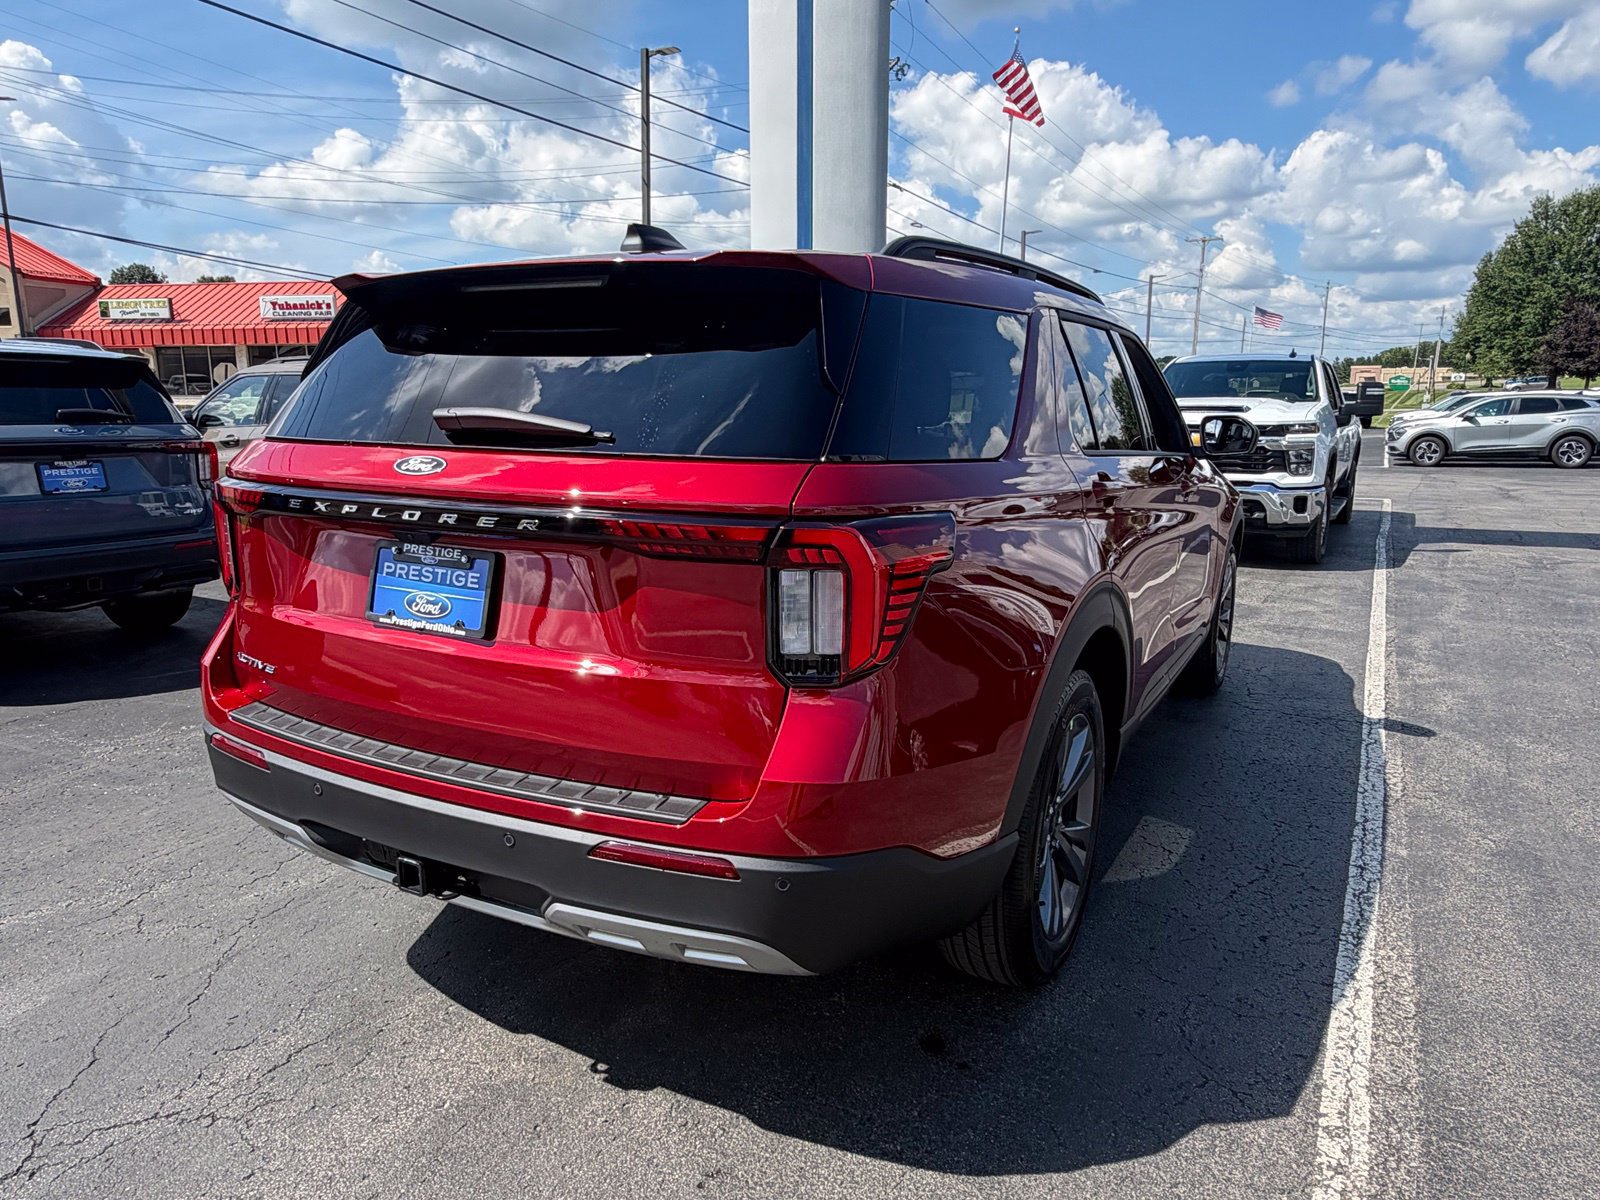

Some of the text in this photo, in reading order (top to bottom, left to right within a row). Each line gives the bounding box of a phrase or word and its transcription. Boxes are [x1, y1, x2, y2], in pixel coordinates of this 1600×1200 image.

[110, 300, 168, 309] LEMON TREE
[270, 300, 332, 311] Yuhanick's
[43, 467, 99, 476] PRESTIGE
[399, 457, 440, 472] Ford
[287, 498, 541, 531] EXPLORER
[402, 543, 462, 559] PRESTIGE
[382, 561, 481, 588] PRESTIGE
[409, 593, 445, 616] Ford
